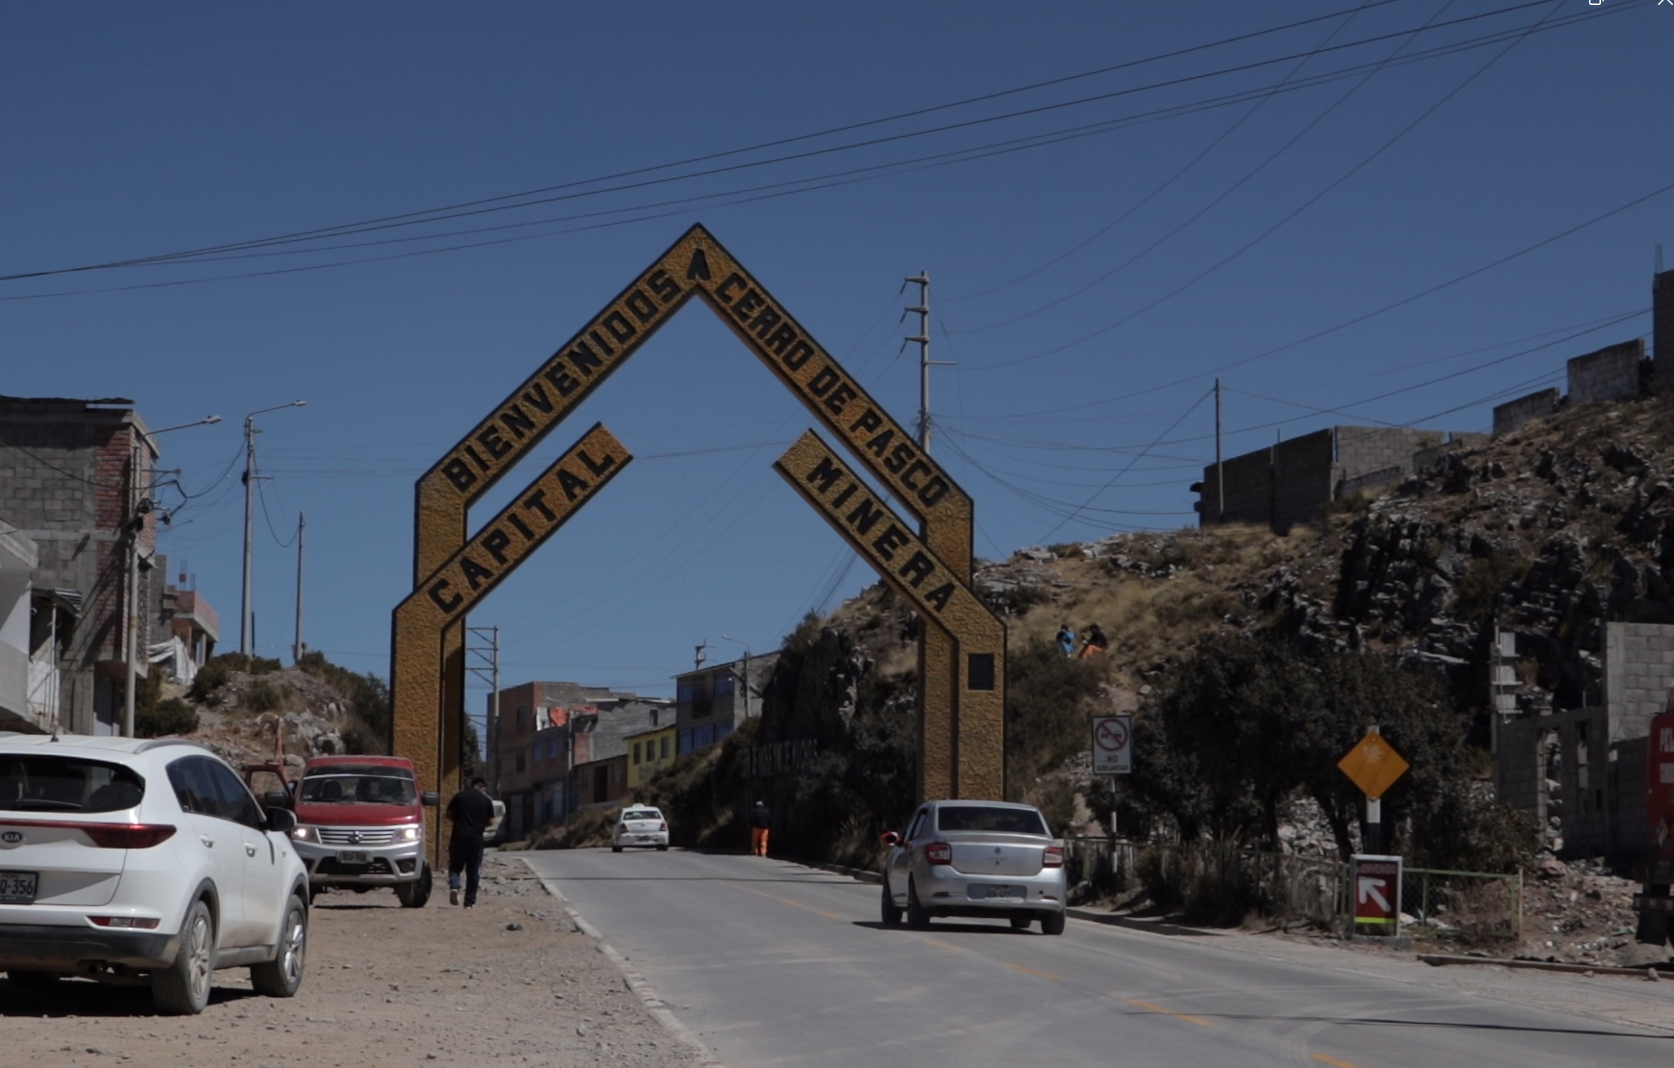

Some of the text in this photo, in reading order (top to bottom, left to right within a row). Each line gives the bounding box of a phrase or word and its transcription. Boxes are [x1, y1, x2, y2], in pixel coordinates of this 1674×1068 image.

[441, 247, 950, 508] BIENVENIDOS A CERRO DE PASCO
[427, 449, 617, 615] CAPITAL
[806, 457, 957, 613] MINERA
[1107, 755, 1118, 763] NO
